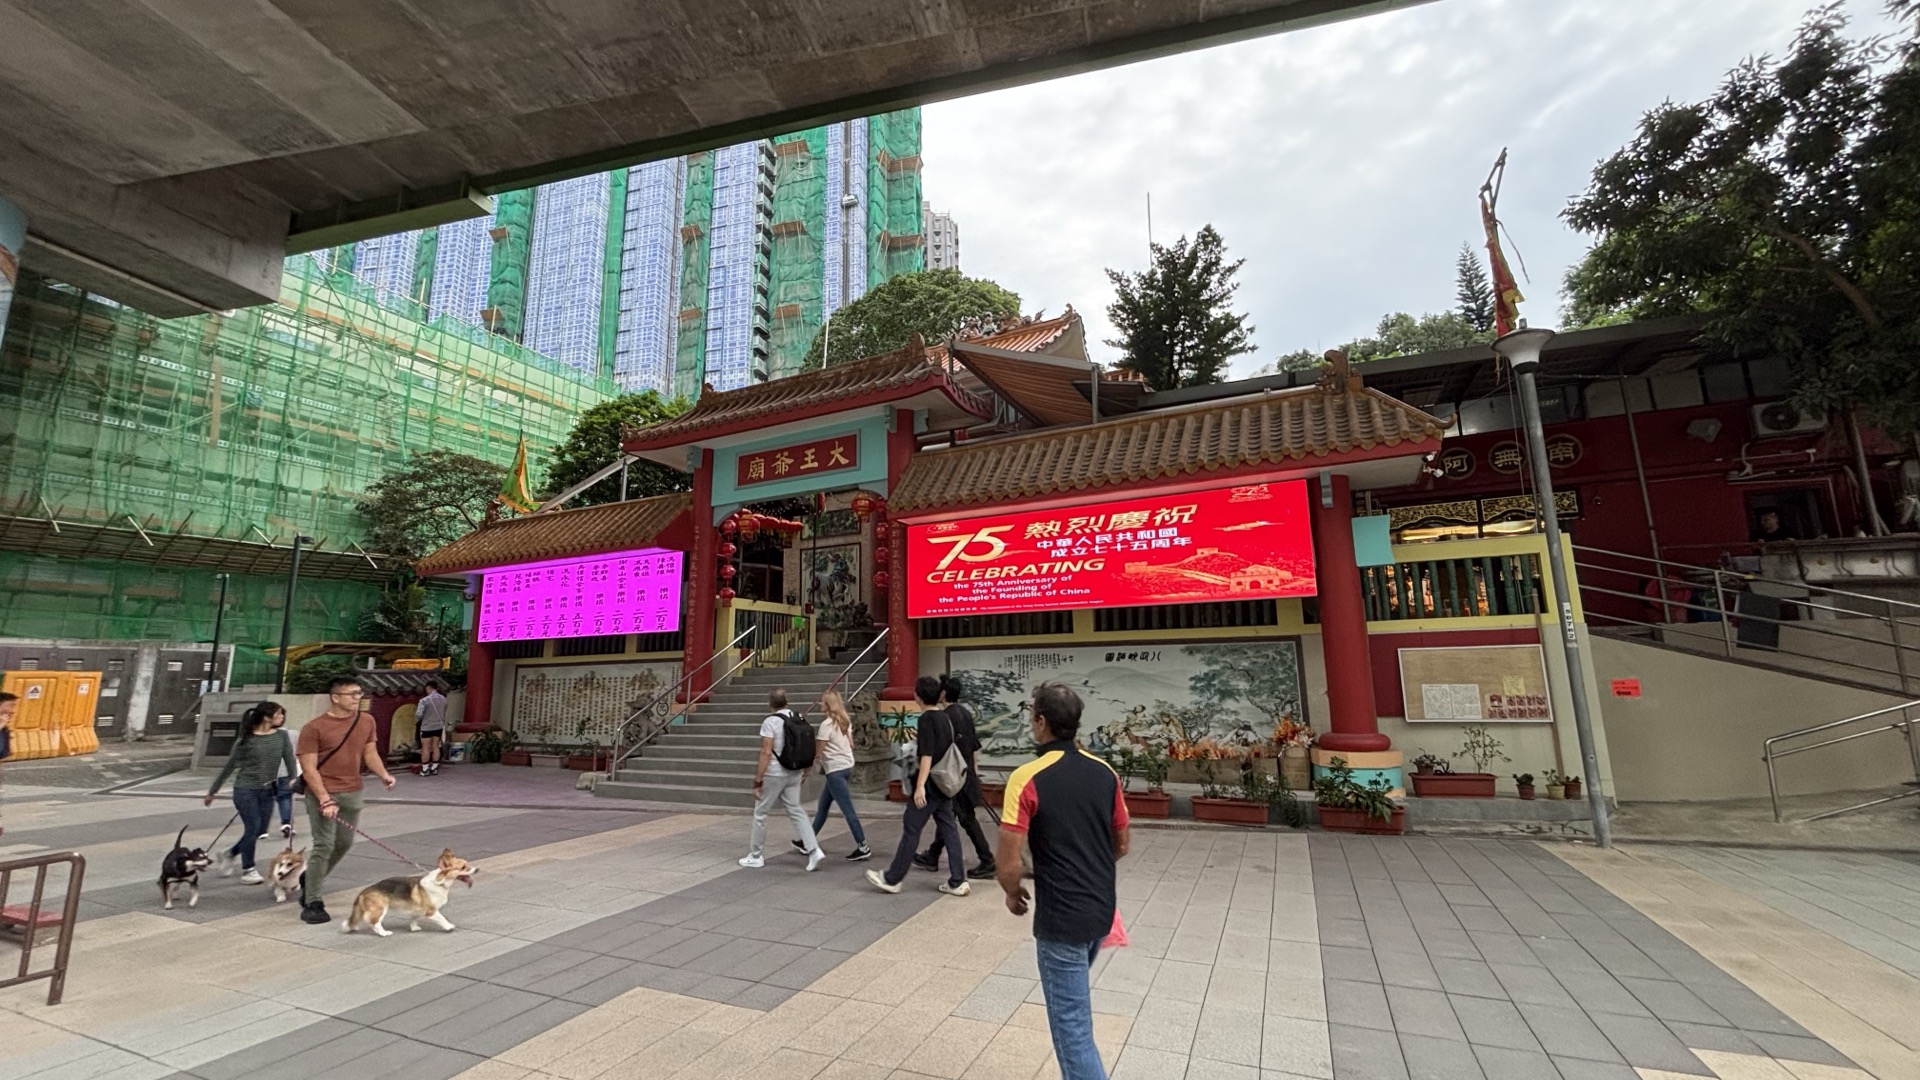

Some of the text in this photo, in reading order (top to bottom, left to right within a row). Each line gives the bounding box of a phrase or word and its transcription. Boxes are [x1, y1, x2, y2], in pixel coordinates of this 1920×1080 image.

[747, 441, 850, 480] 大王爺廟
[1023, 504, 1198, 539] 熱烈慶祝
[927, 524, 1015, 570] 75
[1037, 527, 1178, 549] 中華人民共和國
[1051, 537, 1192, 558] 成立七十五周年
[927, 558, 1106, 583] CELEBRATING
[991, 585, 1037, 593] Founding
[997, 577, 1057, 587] Anniversary
[957, 594, 996, 603] People's
[1000, 591, 1042, 600] Republic
